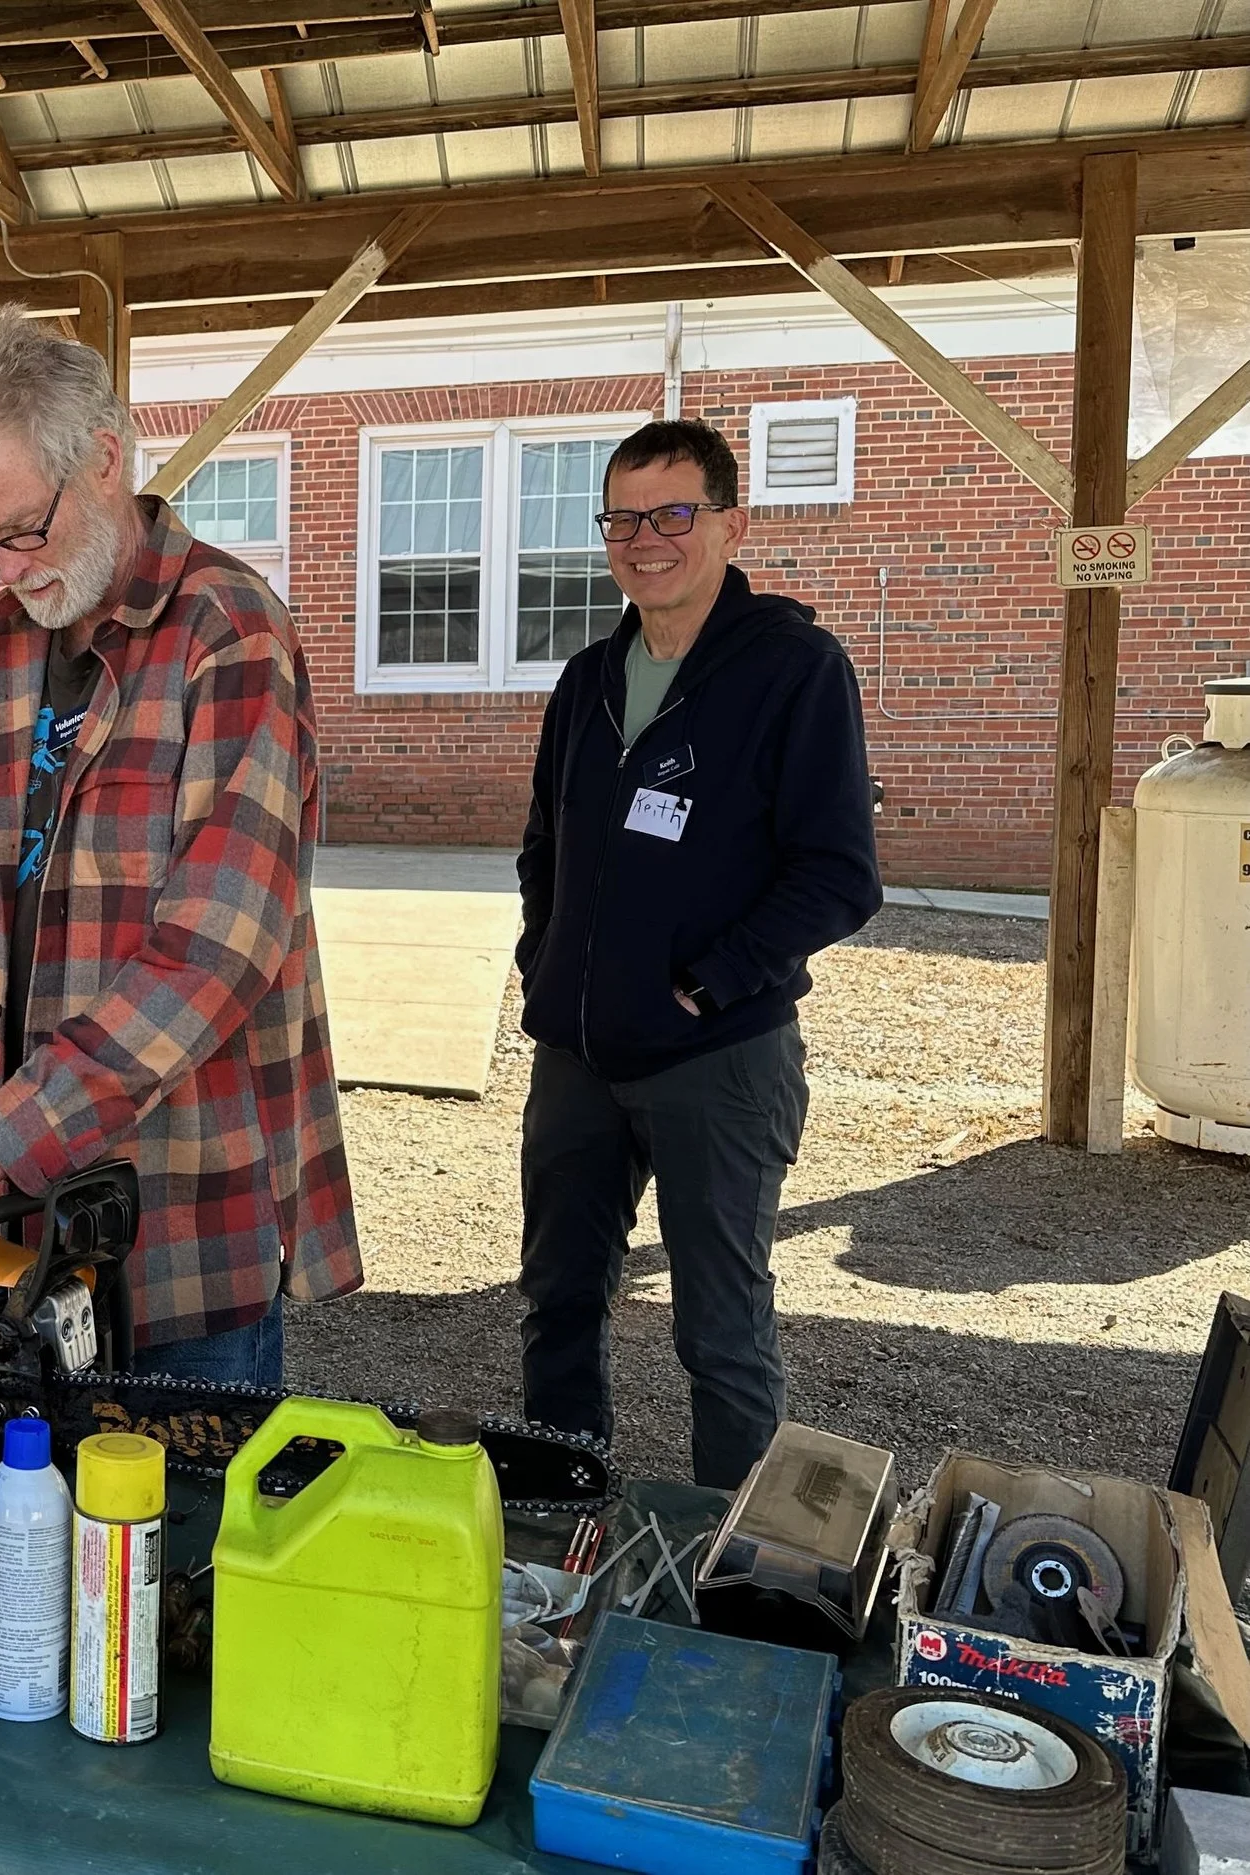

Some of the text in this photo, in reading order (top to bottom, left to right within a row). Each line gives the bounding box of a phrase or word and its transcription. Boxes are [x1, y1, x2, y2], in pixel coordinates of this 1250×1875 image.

[1073, 561, 1136, 572] NO SMOKING
[1076, 571, 1133, 582] NO VAPING
[632, 792, 682, 830] Keith
